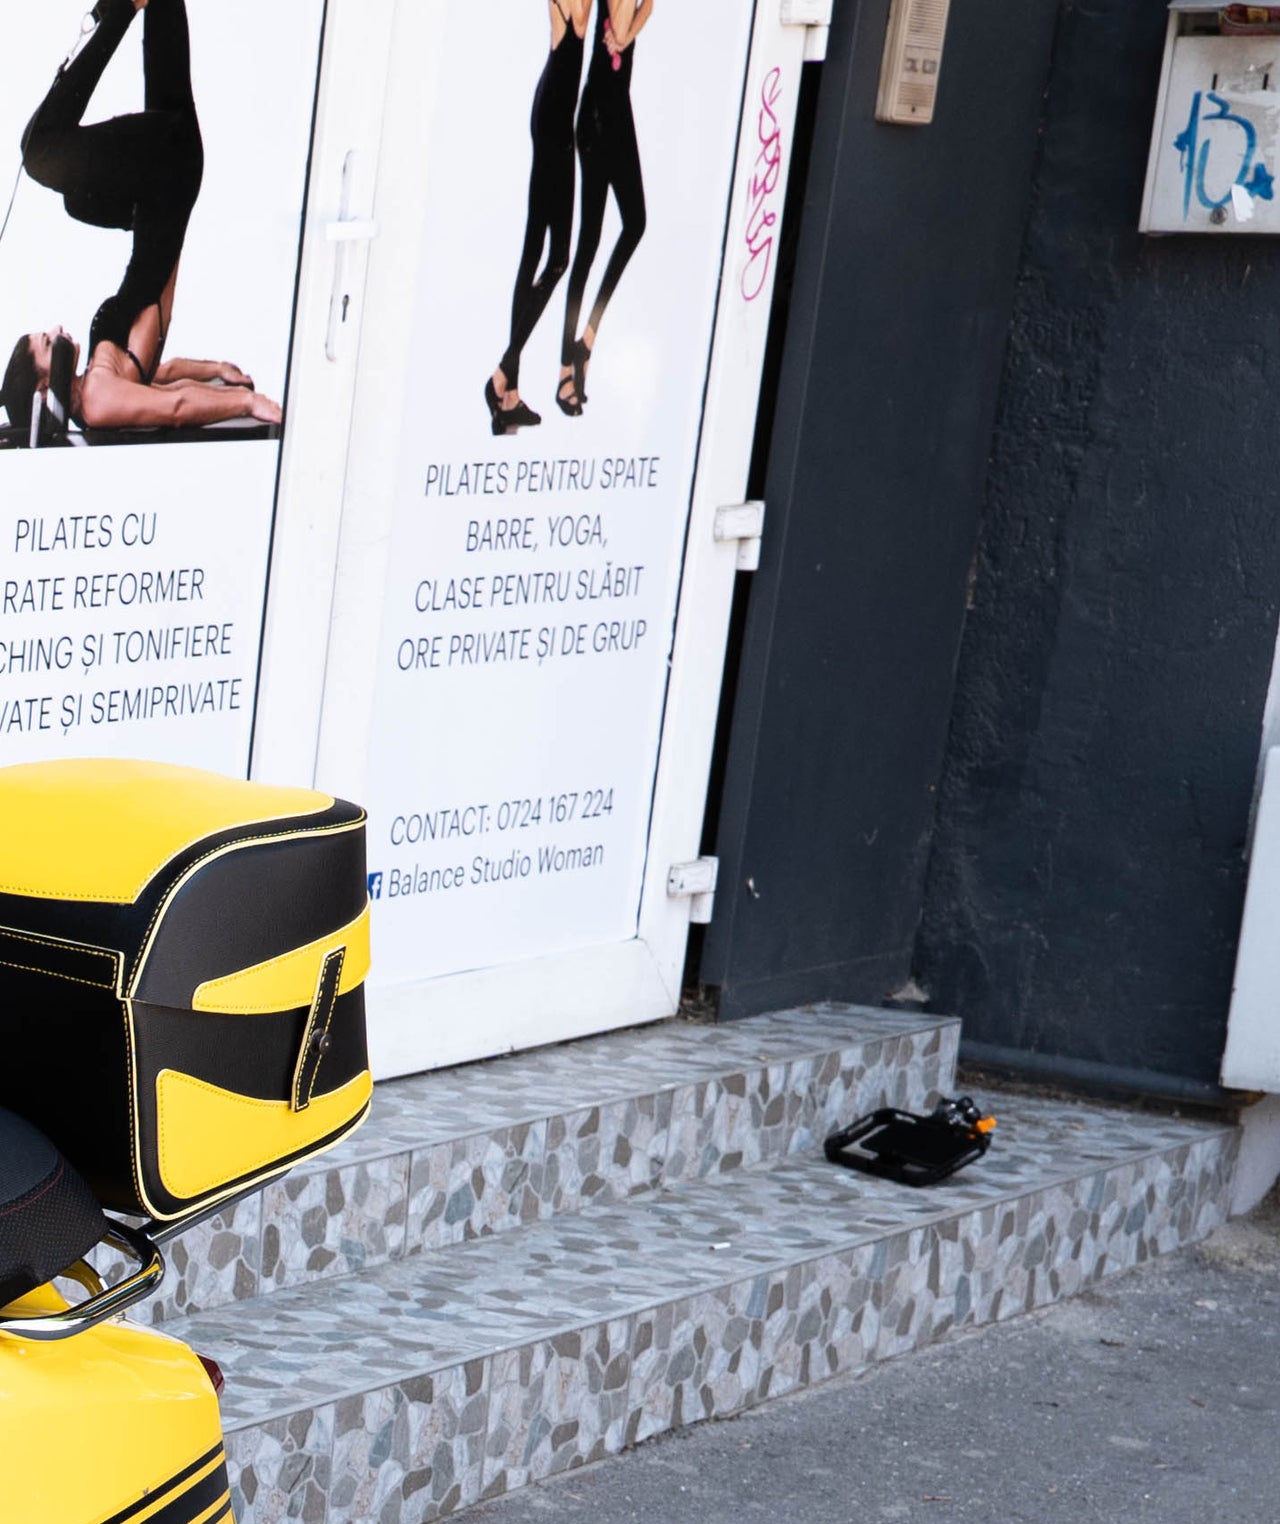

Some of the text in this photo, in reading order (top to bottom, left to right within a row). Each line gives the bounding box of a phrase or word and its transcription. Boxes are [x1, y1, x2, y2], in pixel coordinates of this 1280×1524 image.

[424, 457, 660, 497] PILATES PENTRU SPATE
[15, 512, 157, 553] PILATES CU
[466, 514, 608, 552] BARRE, YOGA,
[73, 568, 205, 609] REFORMER
[415, 561, 644, 613] CLASE PENTRU SLĂBIT
[81, 633, 103, 676] ȘI
[113, 622, 234, 663] TONIFIERE
[397, 636, 443, 671] ORE
[448, 628, 531, 666] PRIVATE
[561, 624, 588, 657] DE
[592, 619, 647, 652] GRUP
[60, 694, 83, 736] ȘI
[90, 678, 243, 724] SEMIPRIVATE
[390, 788, 615, 846] CONTACT: 0724 167 224
[388, 857, 465, 898] Balance
[470, 849, 531, 886] Studio
[537, 844, 604, 874] Woman
